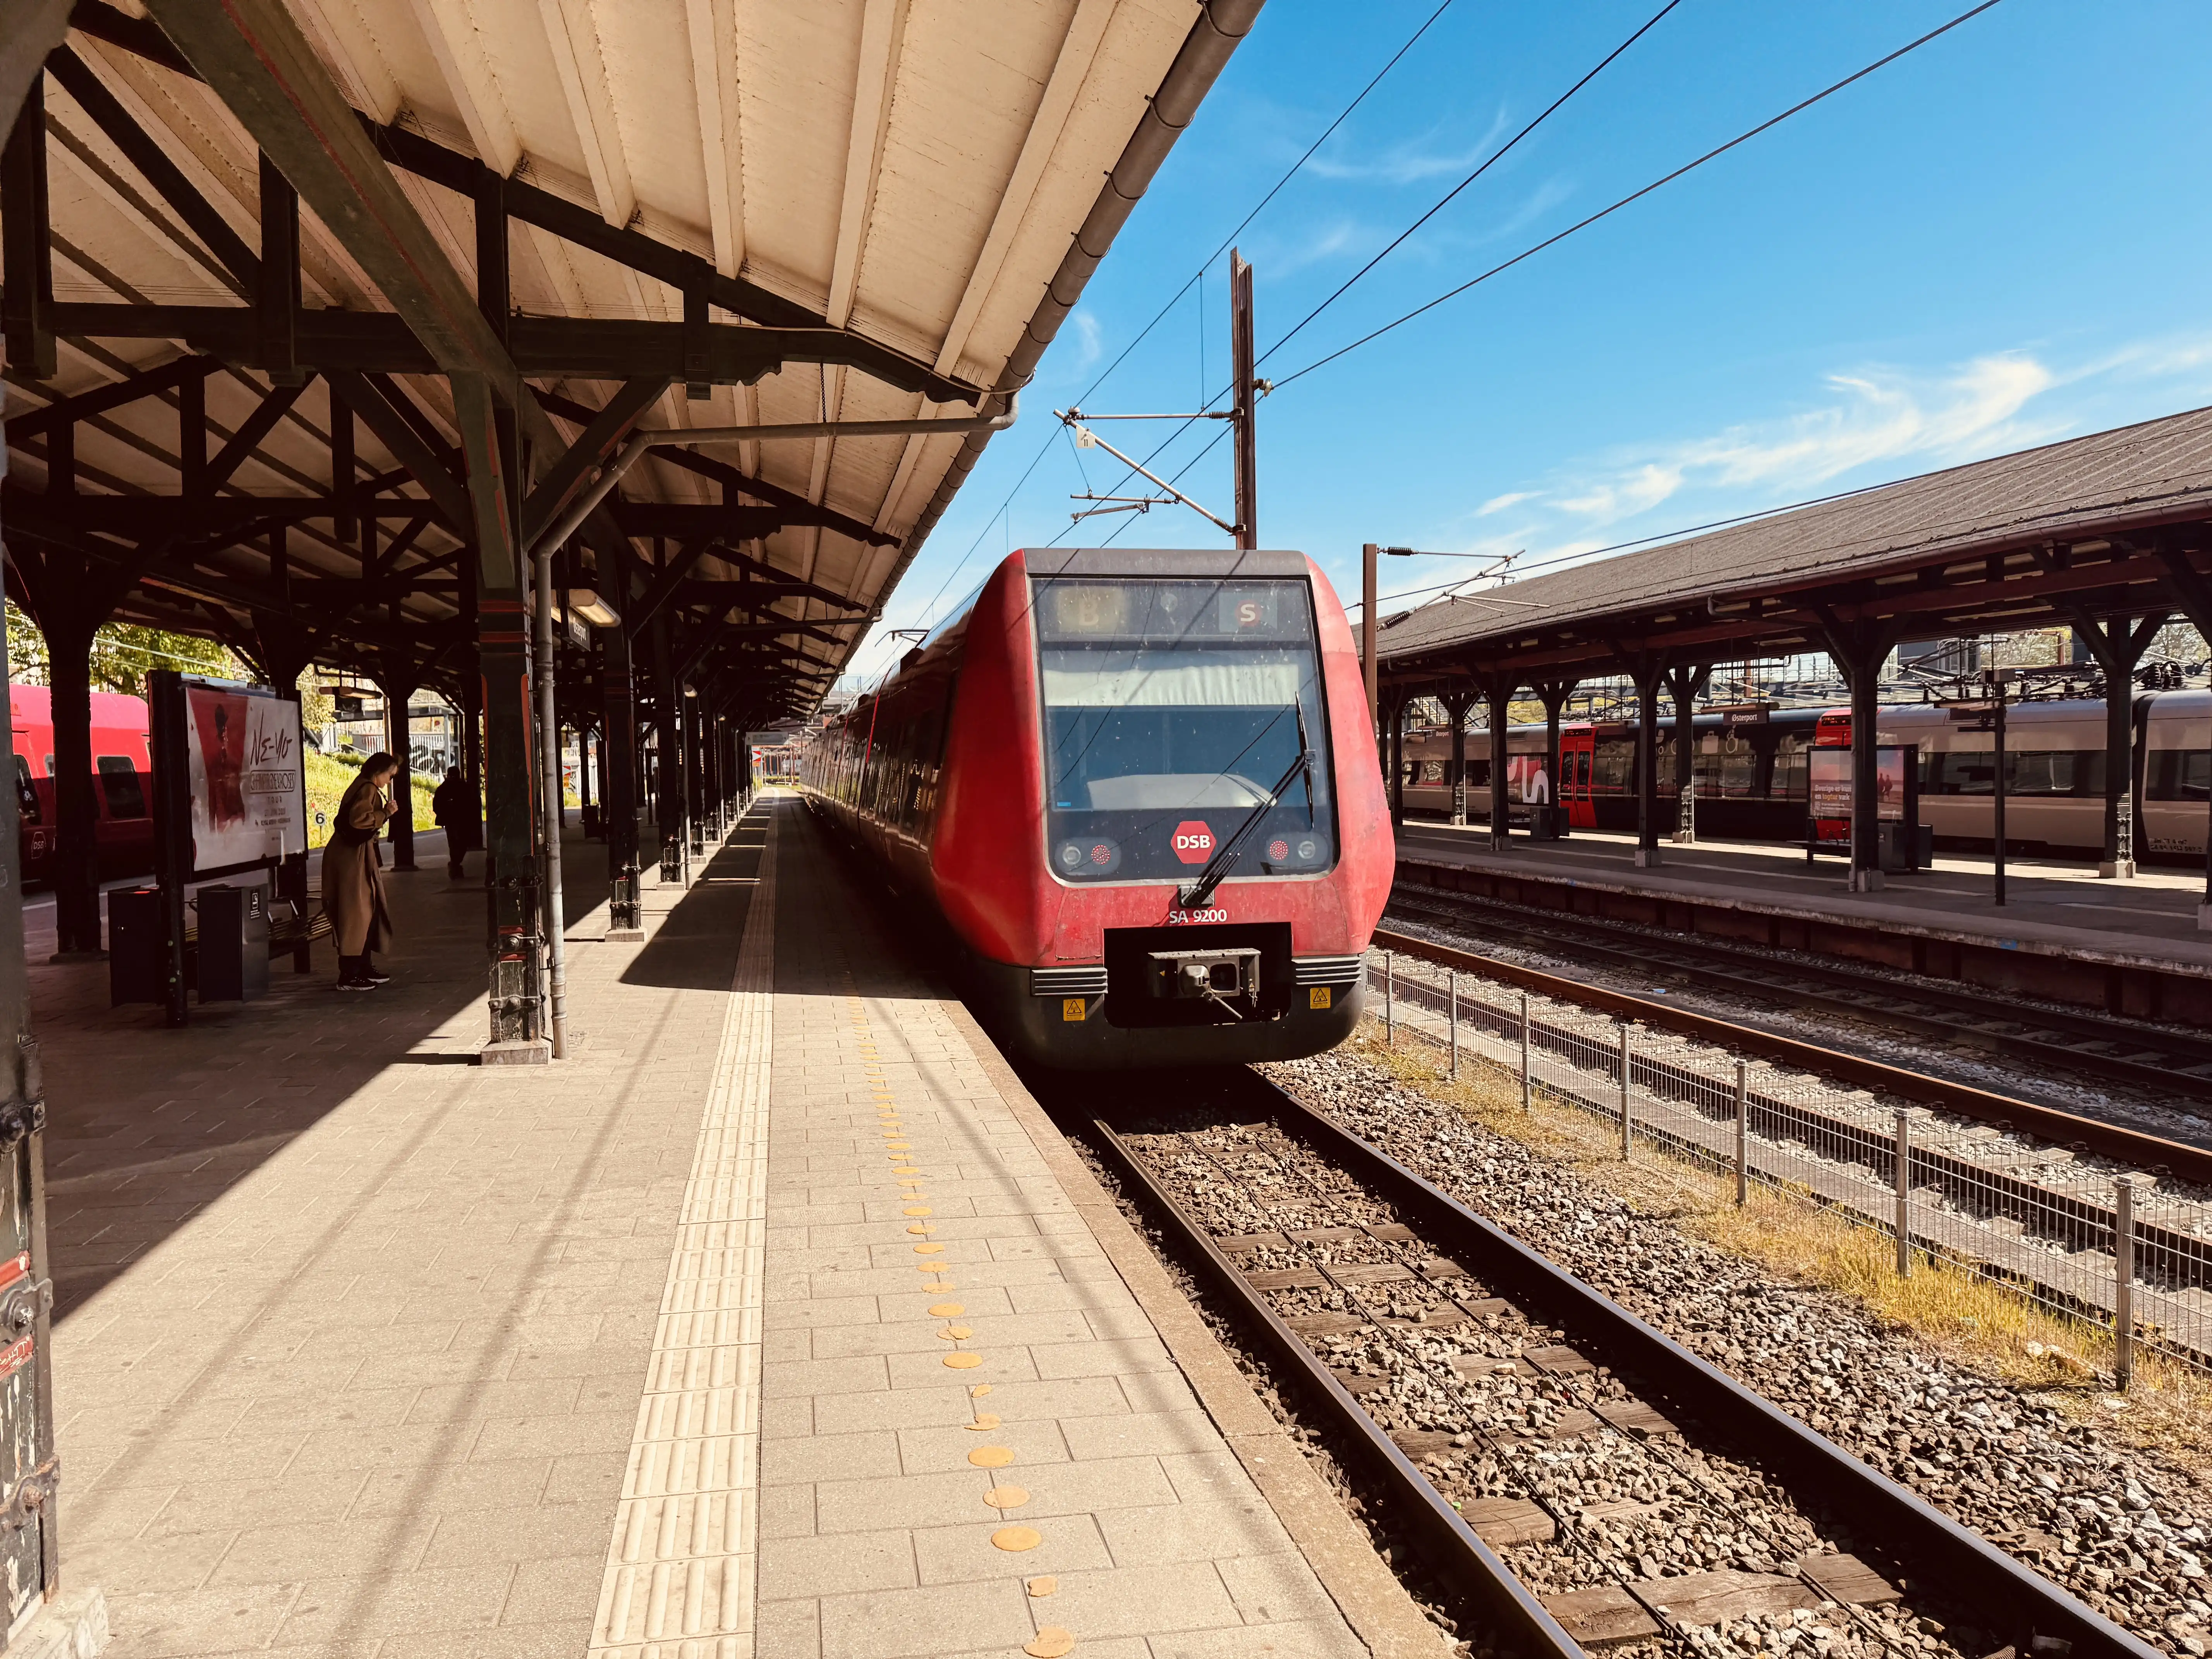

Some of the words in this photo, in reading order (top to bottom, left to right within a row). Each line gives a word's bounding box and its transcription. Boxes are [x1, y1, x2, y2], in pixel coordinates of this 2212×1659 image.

[1084, 439, 1088, 447] 11
[1079, 599, 1099, 626] B
[1240, 604, 1255, 622] S
[1732, 714, 1757, 723] Østerport
[316, 813, 325, 824] 6
[33, 841, 44, 850] DSB
[1177, 835, 1211, 849] DSB
[1169, 910, 1188, 924] SA
[1193, 909, 1227, 922] 9200
